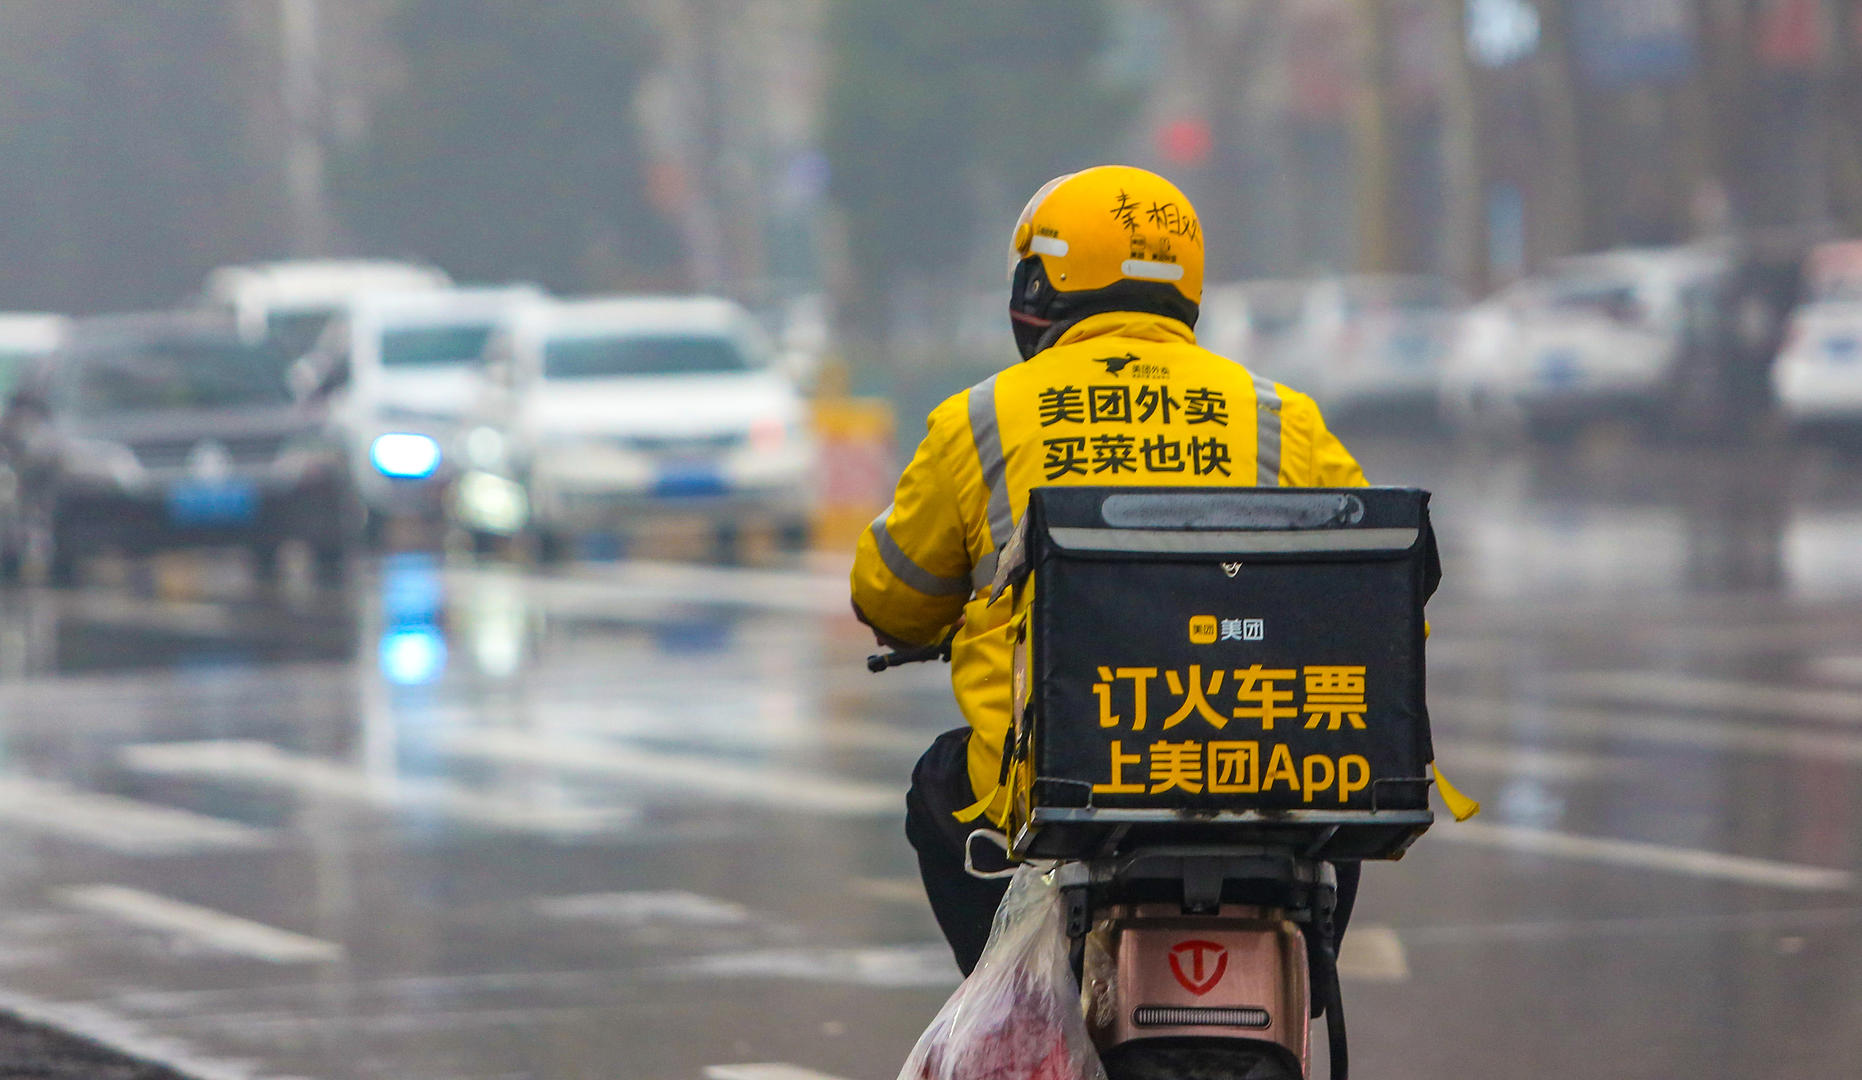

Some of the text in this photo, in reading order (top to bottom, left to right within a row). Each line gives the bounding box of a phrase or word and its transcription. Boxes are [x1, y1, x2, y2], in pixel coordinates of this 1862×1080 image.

[1038, 385, 1229, 427] 美团外卖
[1042, 434, 1232, 481] 买菜也快
[1221, 618, 1264, 641] 美团
[1092, 664, 1368, 731] 订火车票
[1092, 739, 1371, 803] 上美团App
